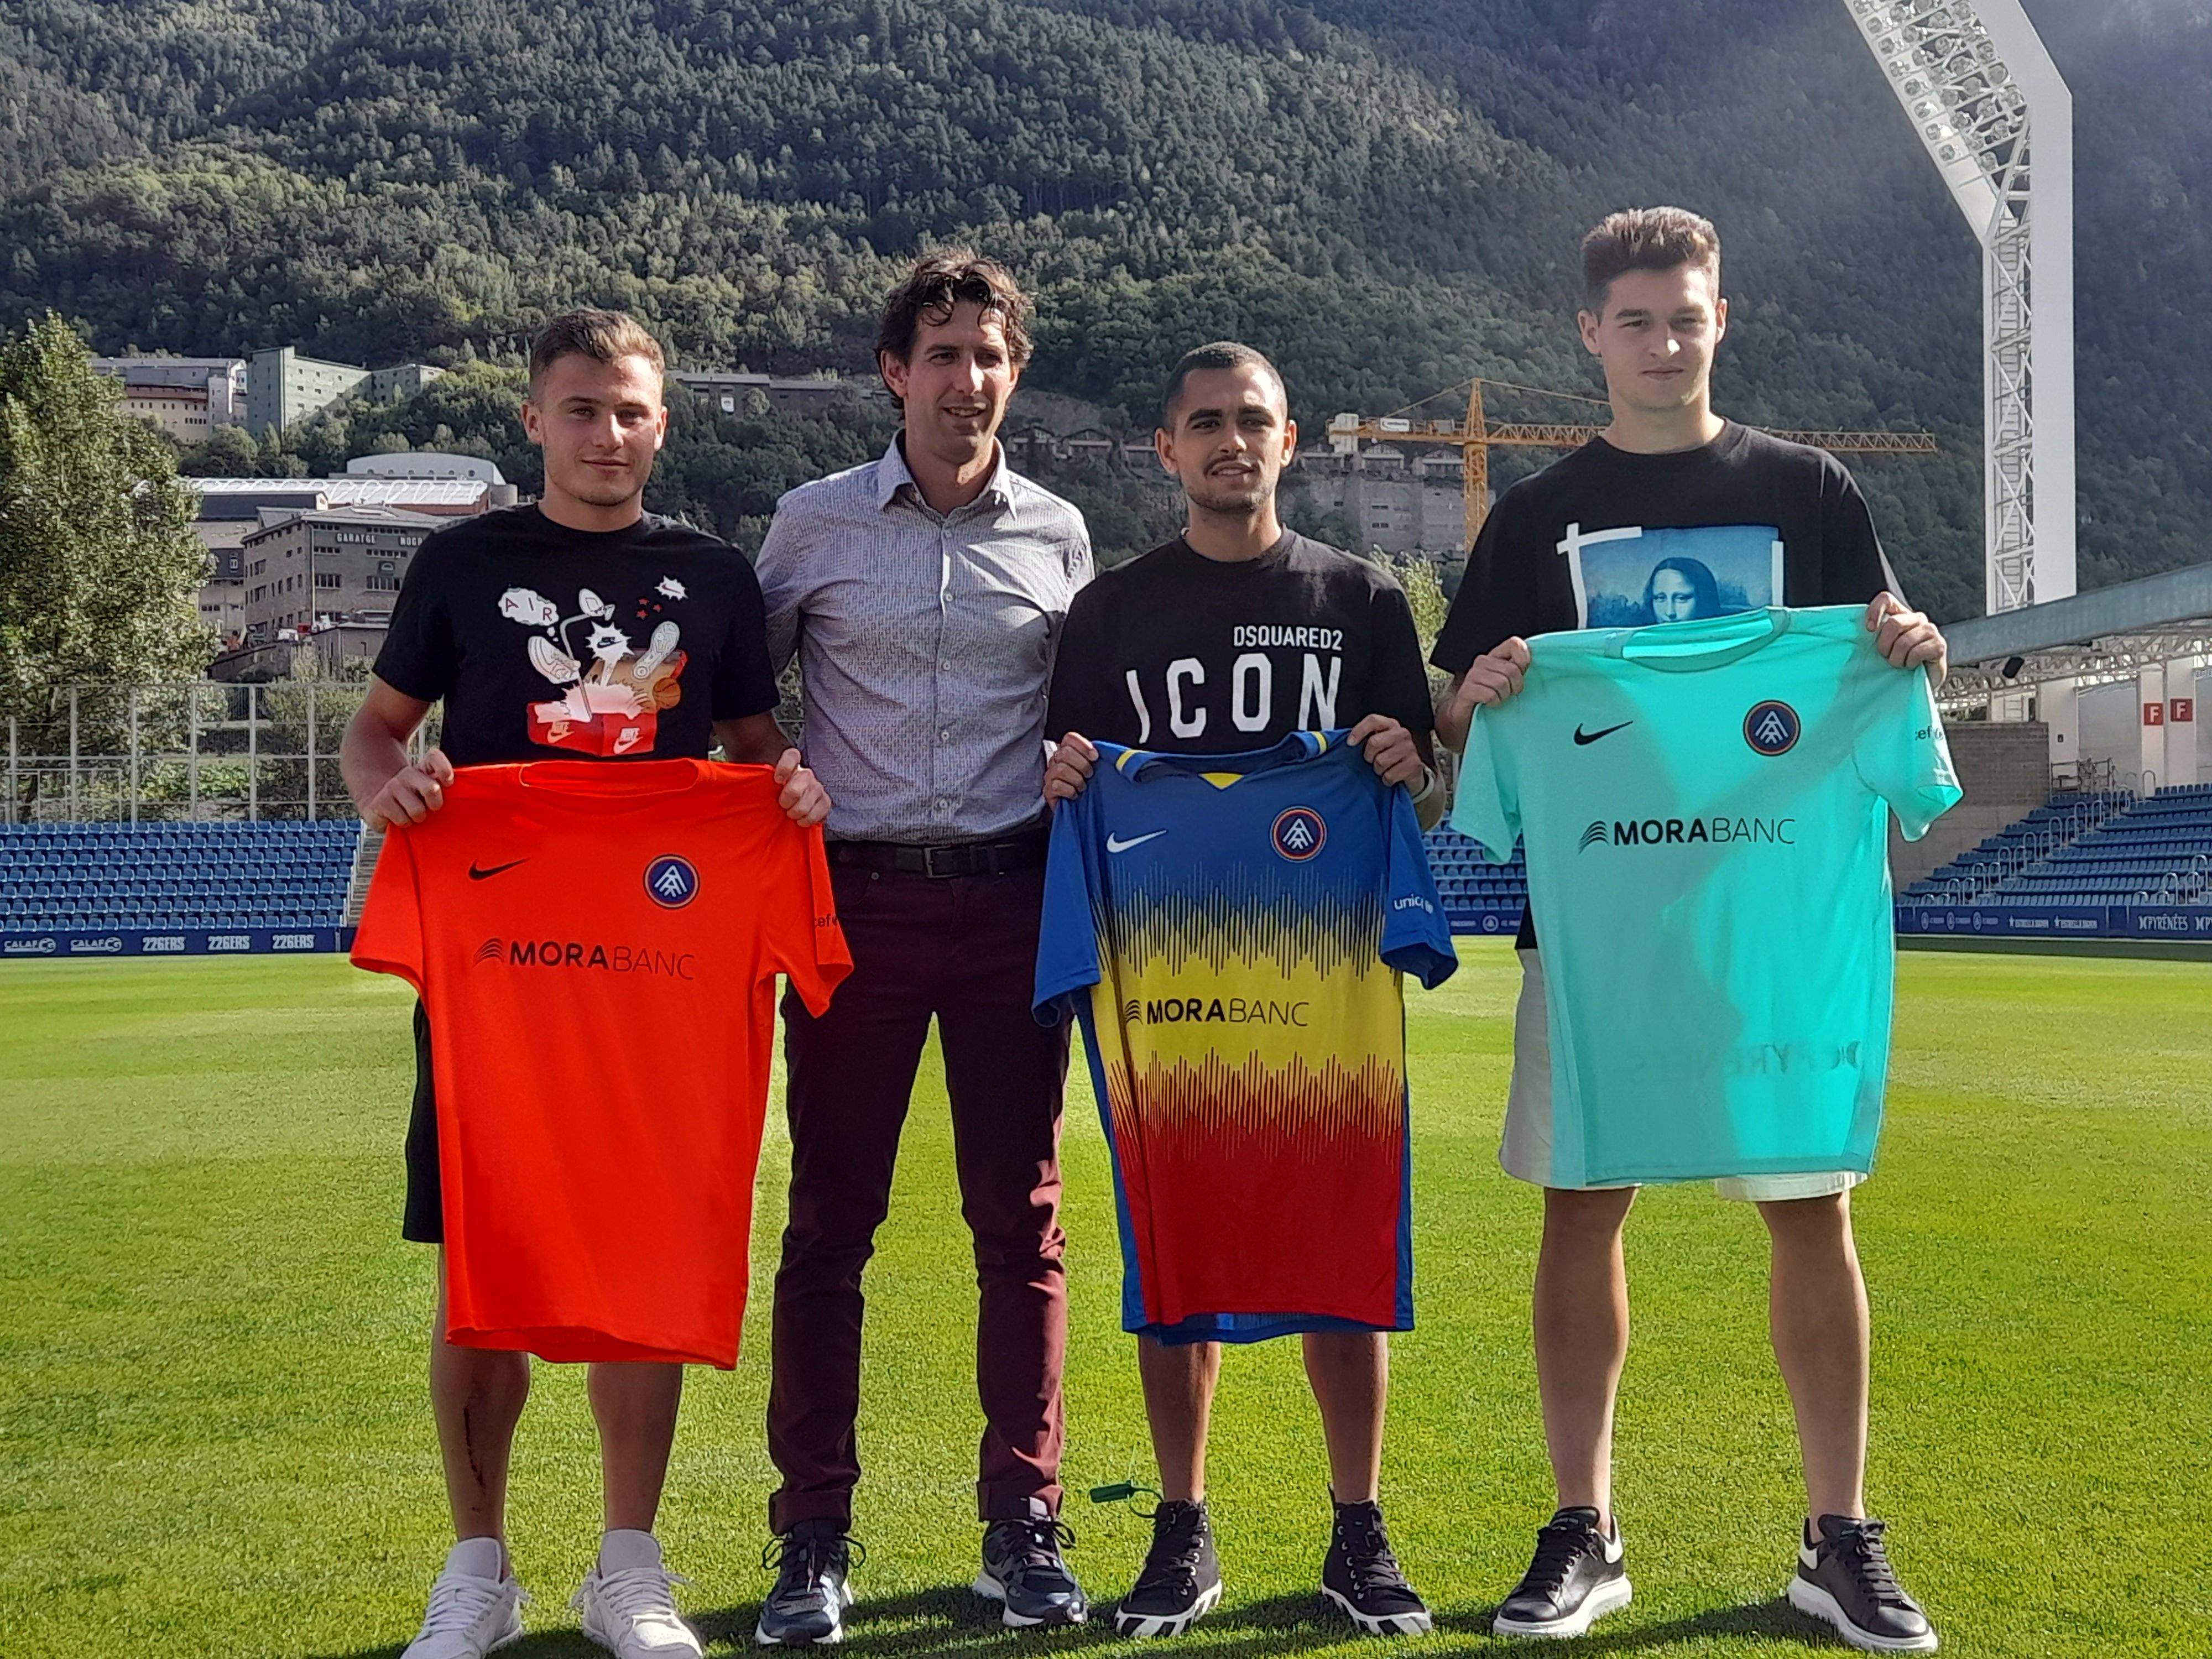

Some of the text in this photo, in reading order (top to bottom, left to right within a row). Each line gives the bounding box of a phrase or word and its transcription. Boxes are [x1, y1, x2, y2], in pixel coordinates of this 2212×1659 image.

[505, 597, 552, 622] AIR
[1233, 625, 1343, 651] DSQUARED2
[1126, 653, 1342, 744] ICON
[2177, 702, 2186, 719] F
[2150, 706, 2159, 723] F
[1614, 818, 1796, 846] MORABANC
[143, 936, 185, 951] 226ERS
[208, 936, 251, 950] 226ERS
[272, 935, 315, 950] 226ERS
[509, 940, 695, 980] MORABANC
[1147, 998, 1309, 1026] MORABANC
